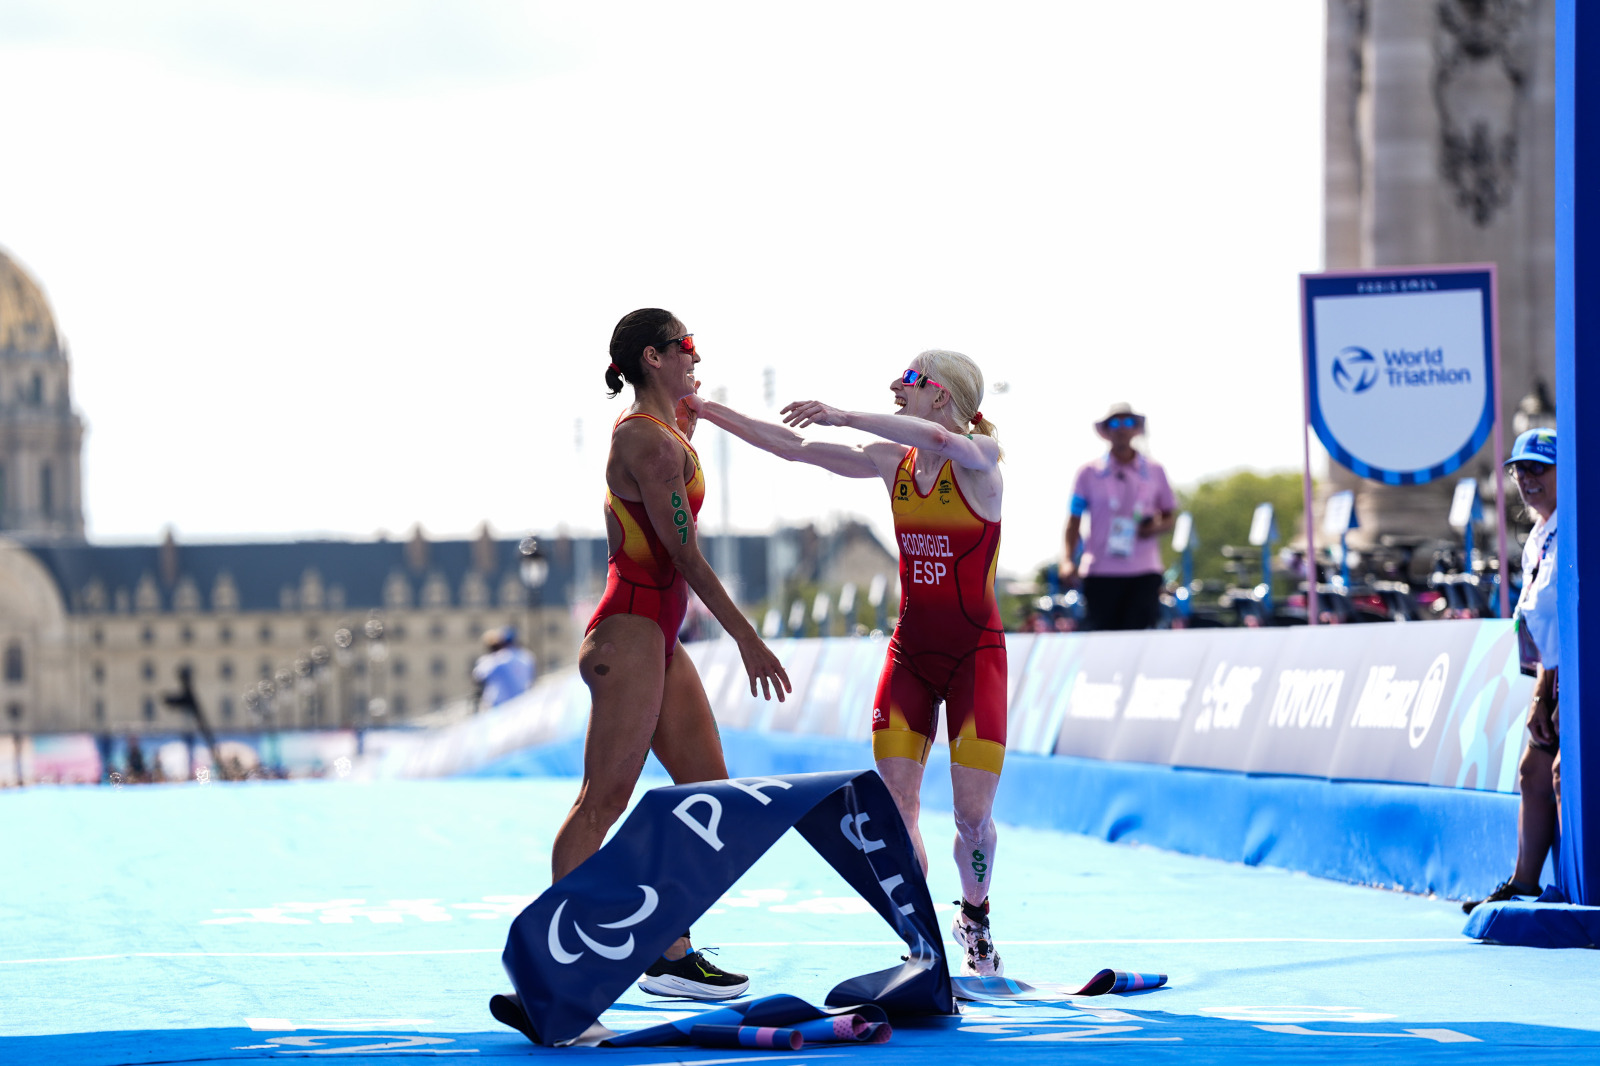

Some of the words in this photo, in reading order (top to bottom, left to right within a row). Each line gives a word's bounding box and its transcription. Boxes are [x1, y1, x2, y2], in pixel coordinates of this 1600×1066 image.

[1383, 346, 1443, 367] World
[1385, 367, 1472, 388] Triathlon
[901, 533, 954, 558] RODRIGUEZ
[913, 560, 947, 585] ESP
[1268, 668, 1345, 729] TOYOTA
